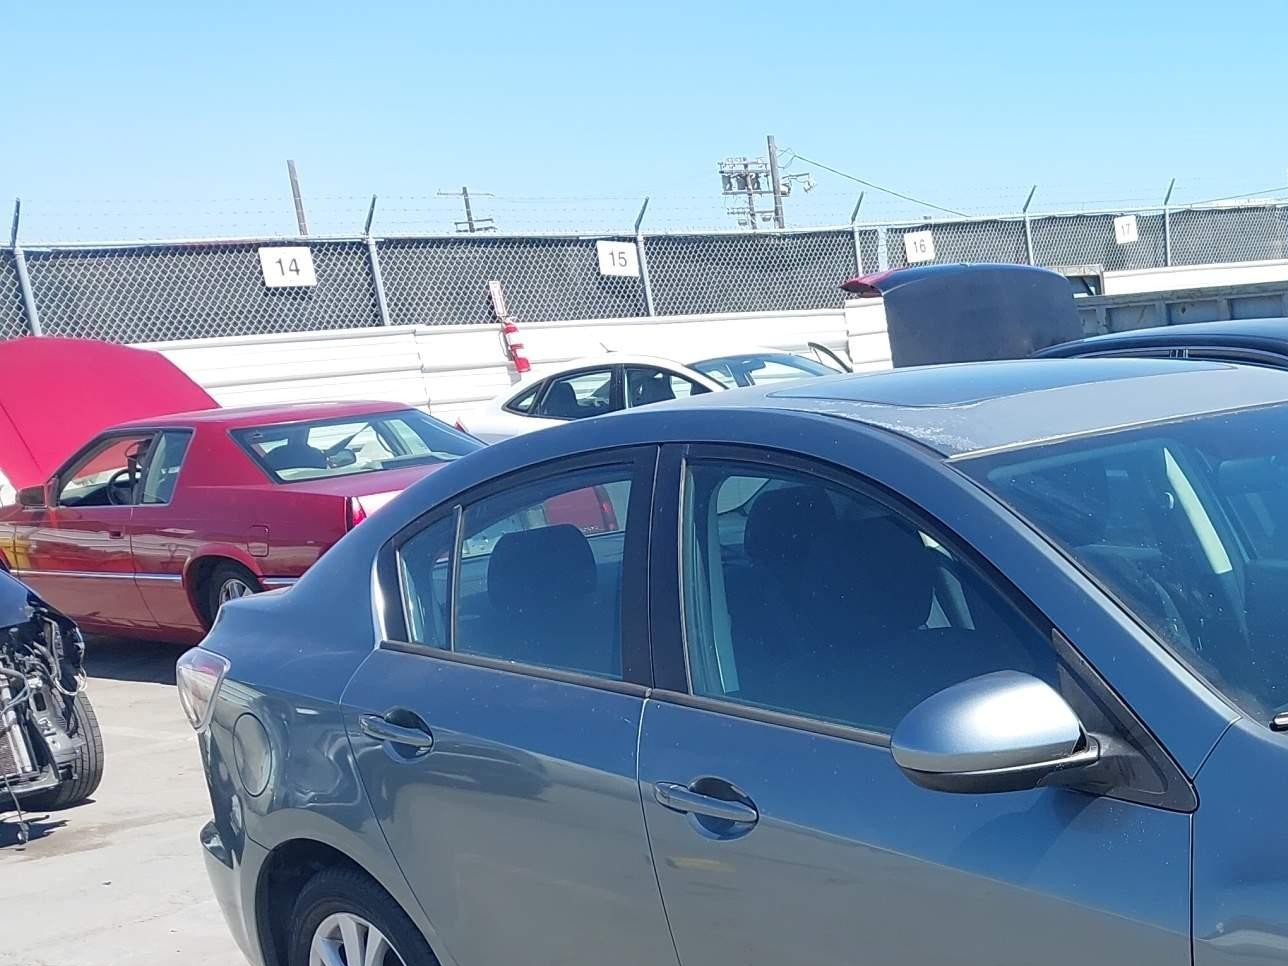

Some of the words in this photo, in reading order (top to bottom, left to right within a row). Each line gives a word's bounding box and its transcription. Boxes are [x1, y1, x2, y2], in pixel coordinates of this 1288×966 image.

[914, 238, 927, 254] 16
[275, 257, 300, 277] 14
[608, 247, 627, 267] 15
